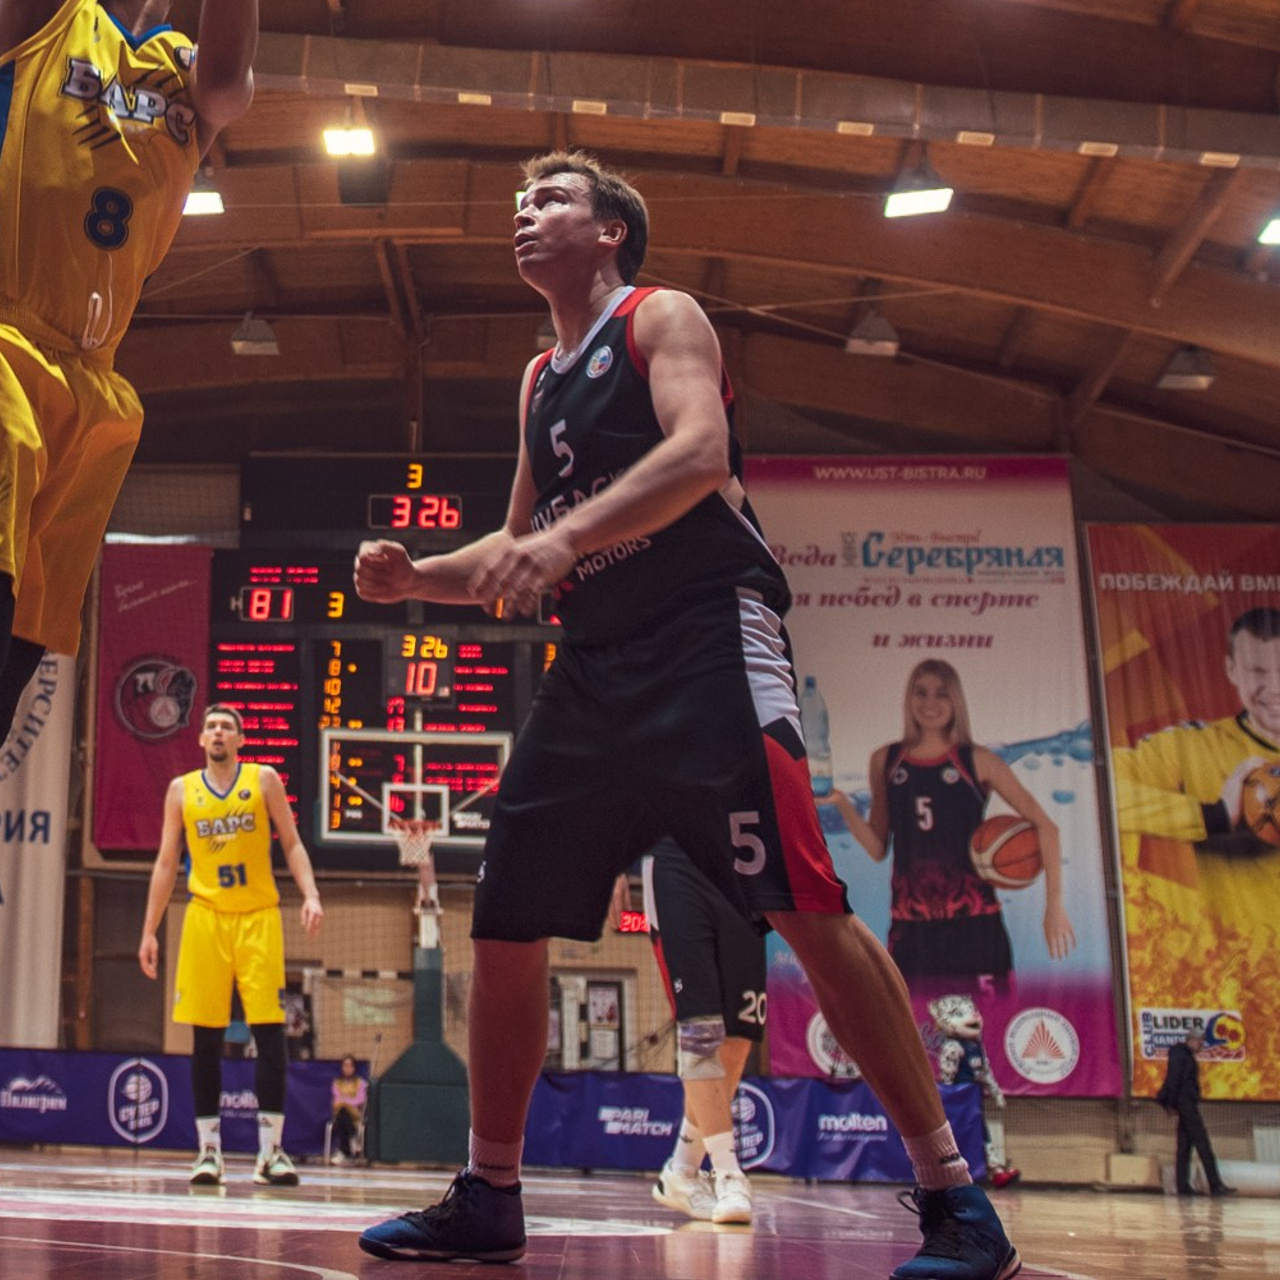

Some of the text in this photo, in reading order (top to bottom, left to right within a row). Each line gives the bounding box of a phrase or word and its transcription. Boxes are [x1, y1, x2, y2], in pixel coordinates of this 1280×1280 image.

[84, 186, 133, 250] 8
[550, 419, 575, 477] 5
[406, 463, 423, 488] 3
[575, 536, 652, 581] MOTORS
[862, 530, 1065, 576] Серебряная
[1099, 570, 1234, 595] ПОБЕЖДАЙ
[249, 587, 292, 620] 81
[327, 591, 344, 617] 3
[406, 661, 437, 695] 10
[195, 812, 256, 838] БАРС
[915, 795, 934, 831] 5
[728, 810, 767, 876] 5
[218, 863, 247, 889] 51
[738, 989, 768, 1025] 20
[1153, 1015, 1205, 1031] LIDER
[616, 1122, 673, 1136] MATCH
[818, 1111, 888, 1132] molten
